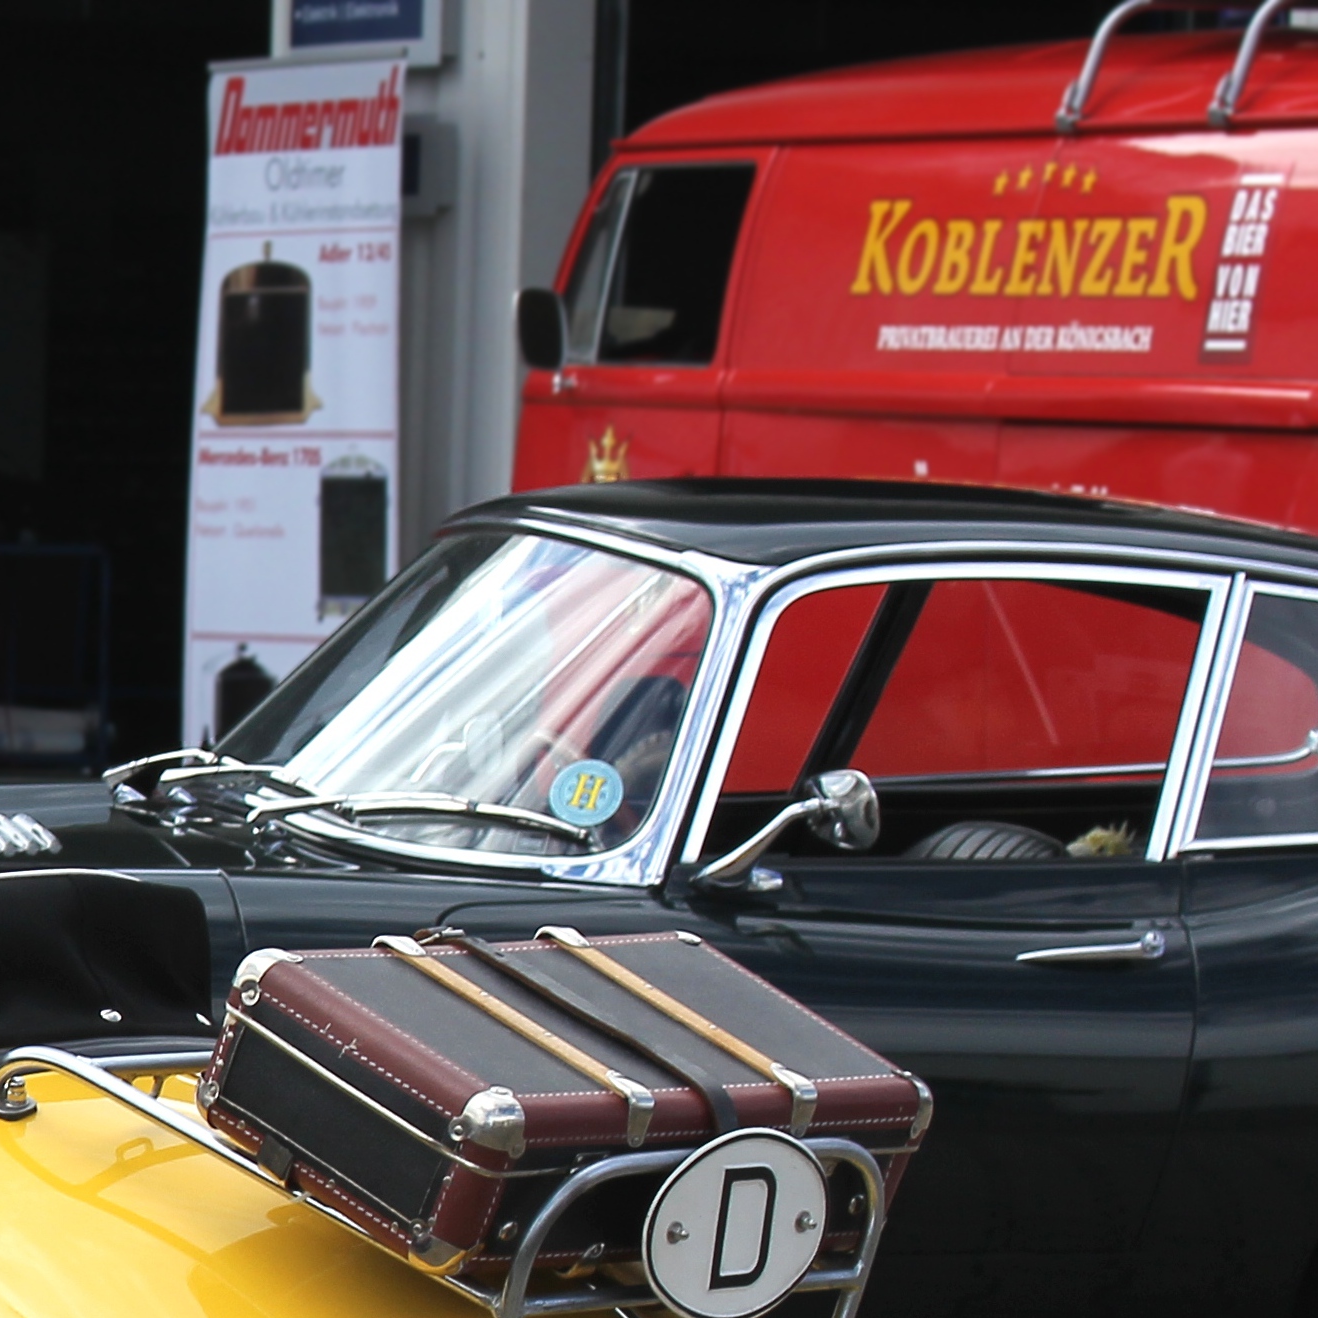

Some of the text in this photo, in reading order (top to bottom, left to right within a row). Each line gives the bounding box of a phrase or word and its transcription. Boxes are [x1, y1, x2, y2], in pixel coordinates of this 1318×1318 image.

[1231, 189, 1278, 222] DAS
[850, 194, 1207, 301] KOBLENZER
[1222, 223, 1269, 258] BIER
[1215, 264, 1260, 298] VON
[1206, 300, 1253, 334] HIER
[568, 773, 606, 810] H
[709, 1164, 777, 1290] D
